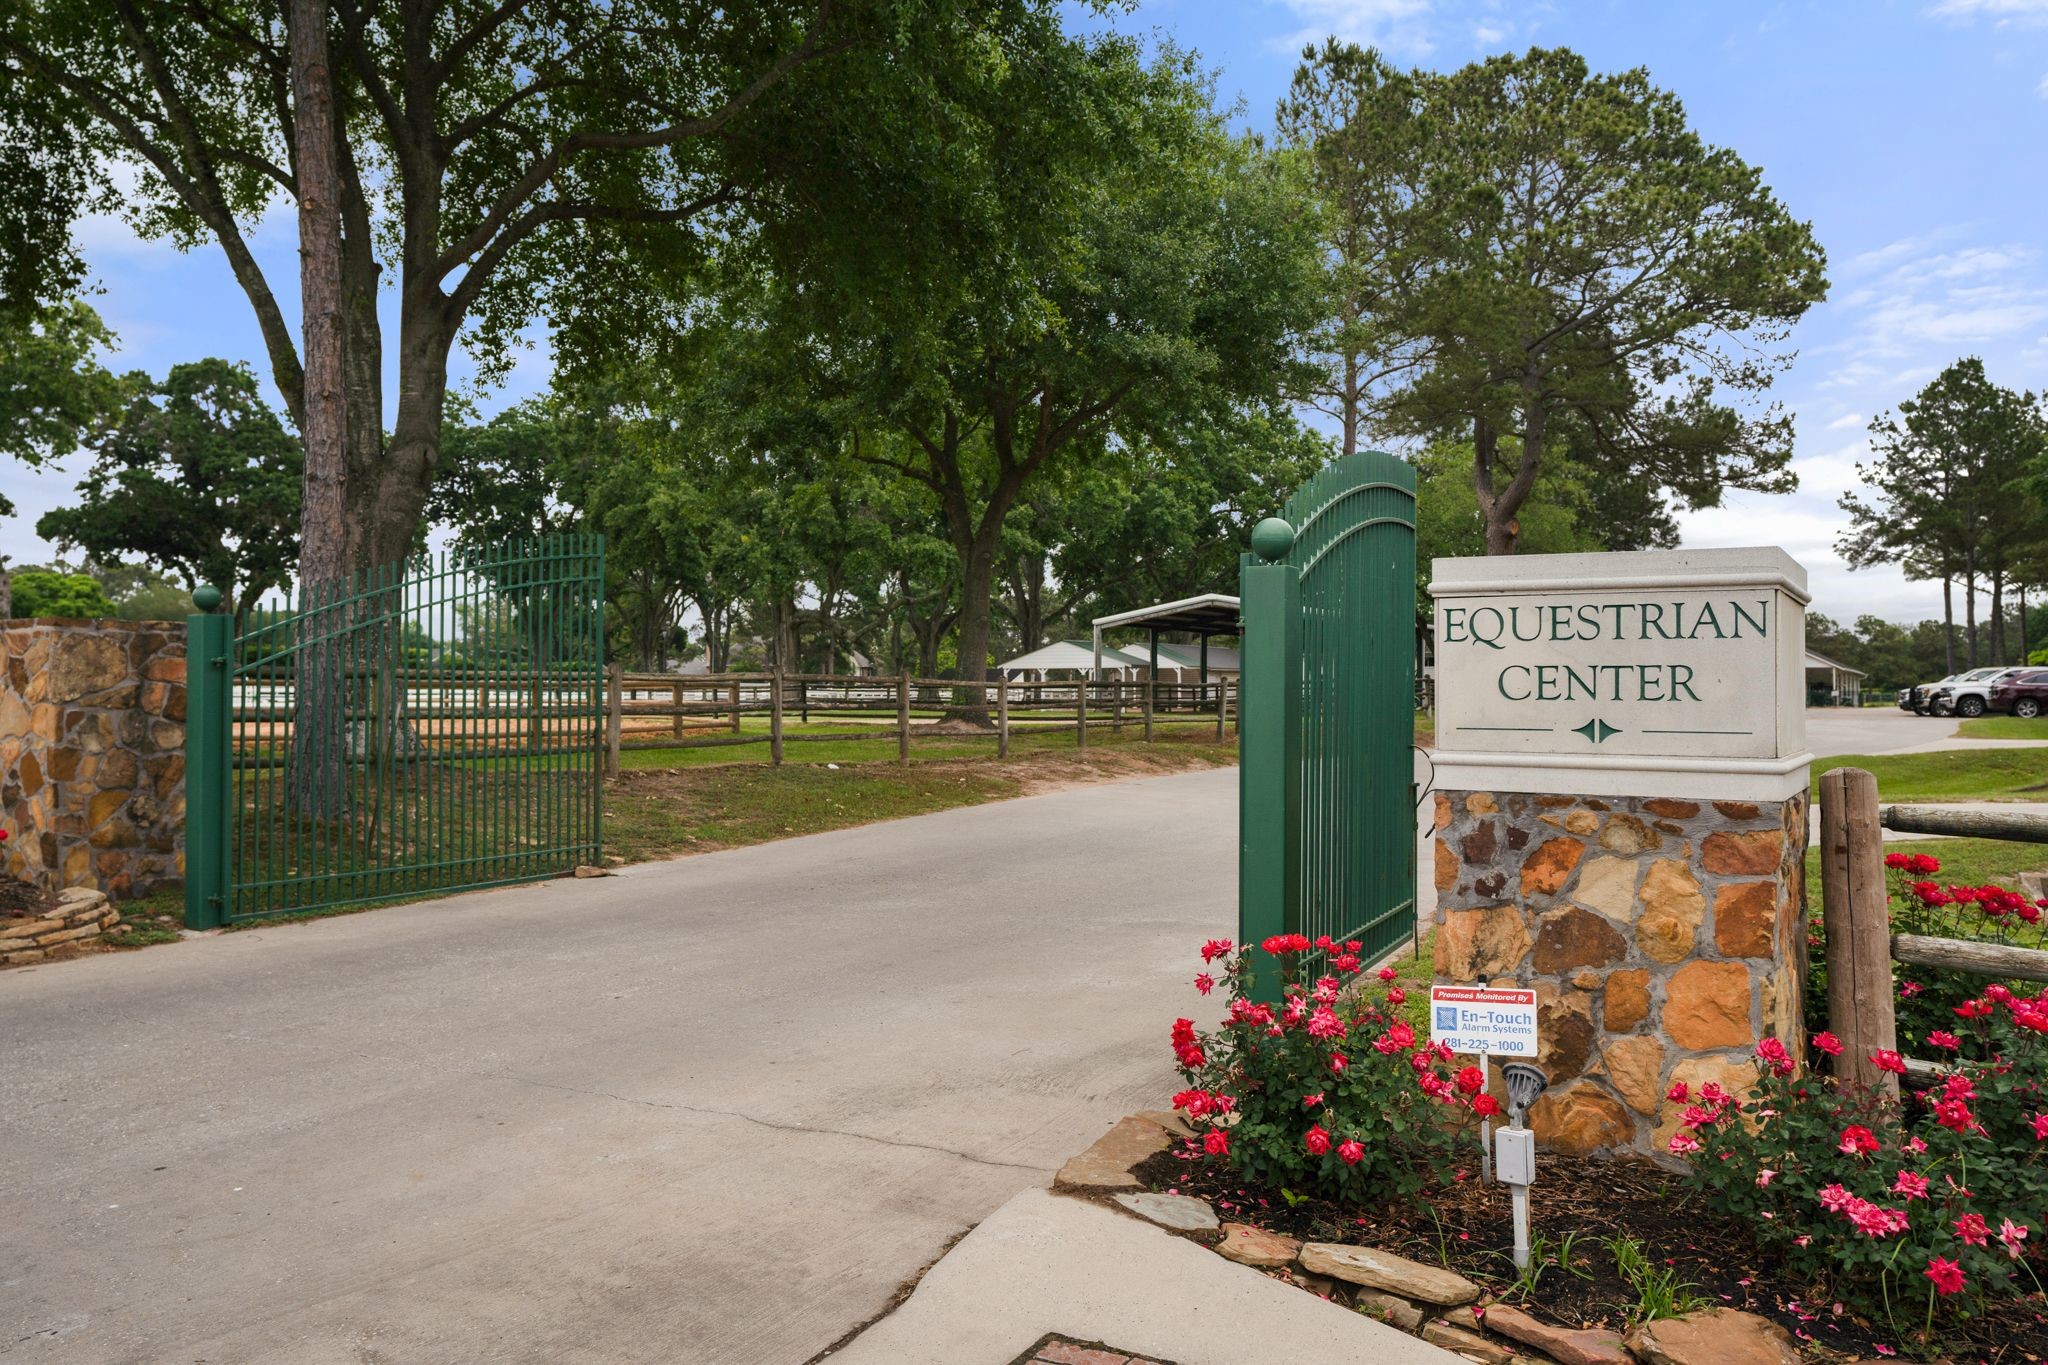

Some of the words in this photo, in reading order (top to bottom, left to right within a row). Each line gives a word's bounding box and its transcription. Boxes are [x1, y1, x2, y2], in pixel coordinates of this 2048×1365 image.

[1443, 600, 1769, 650] EQUESTRIAN
[1498, 664, 1703, 702] CENTER
[1438, 991, 1474, 999] Premises
[1475, 992, 1516, 1001] Monitored
[1461, 1010, 1532, 1025] En-Touch
[1461, 1023, 1490, 1032] Alarm
[1493, 1024, 1532, 1035] Systems
[1445, 1037, 1524, 1051] 281-225-1000
